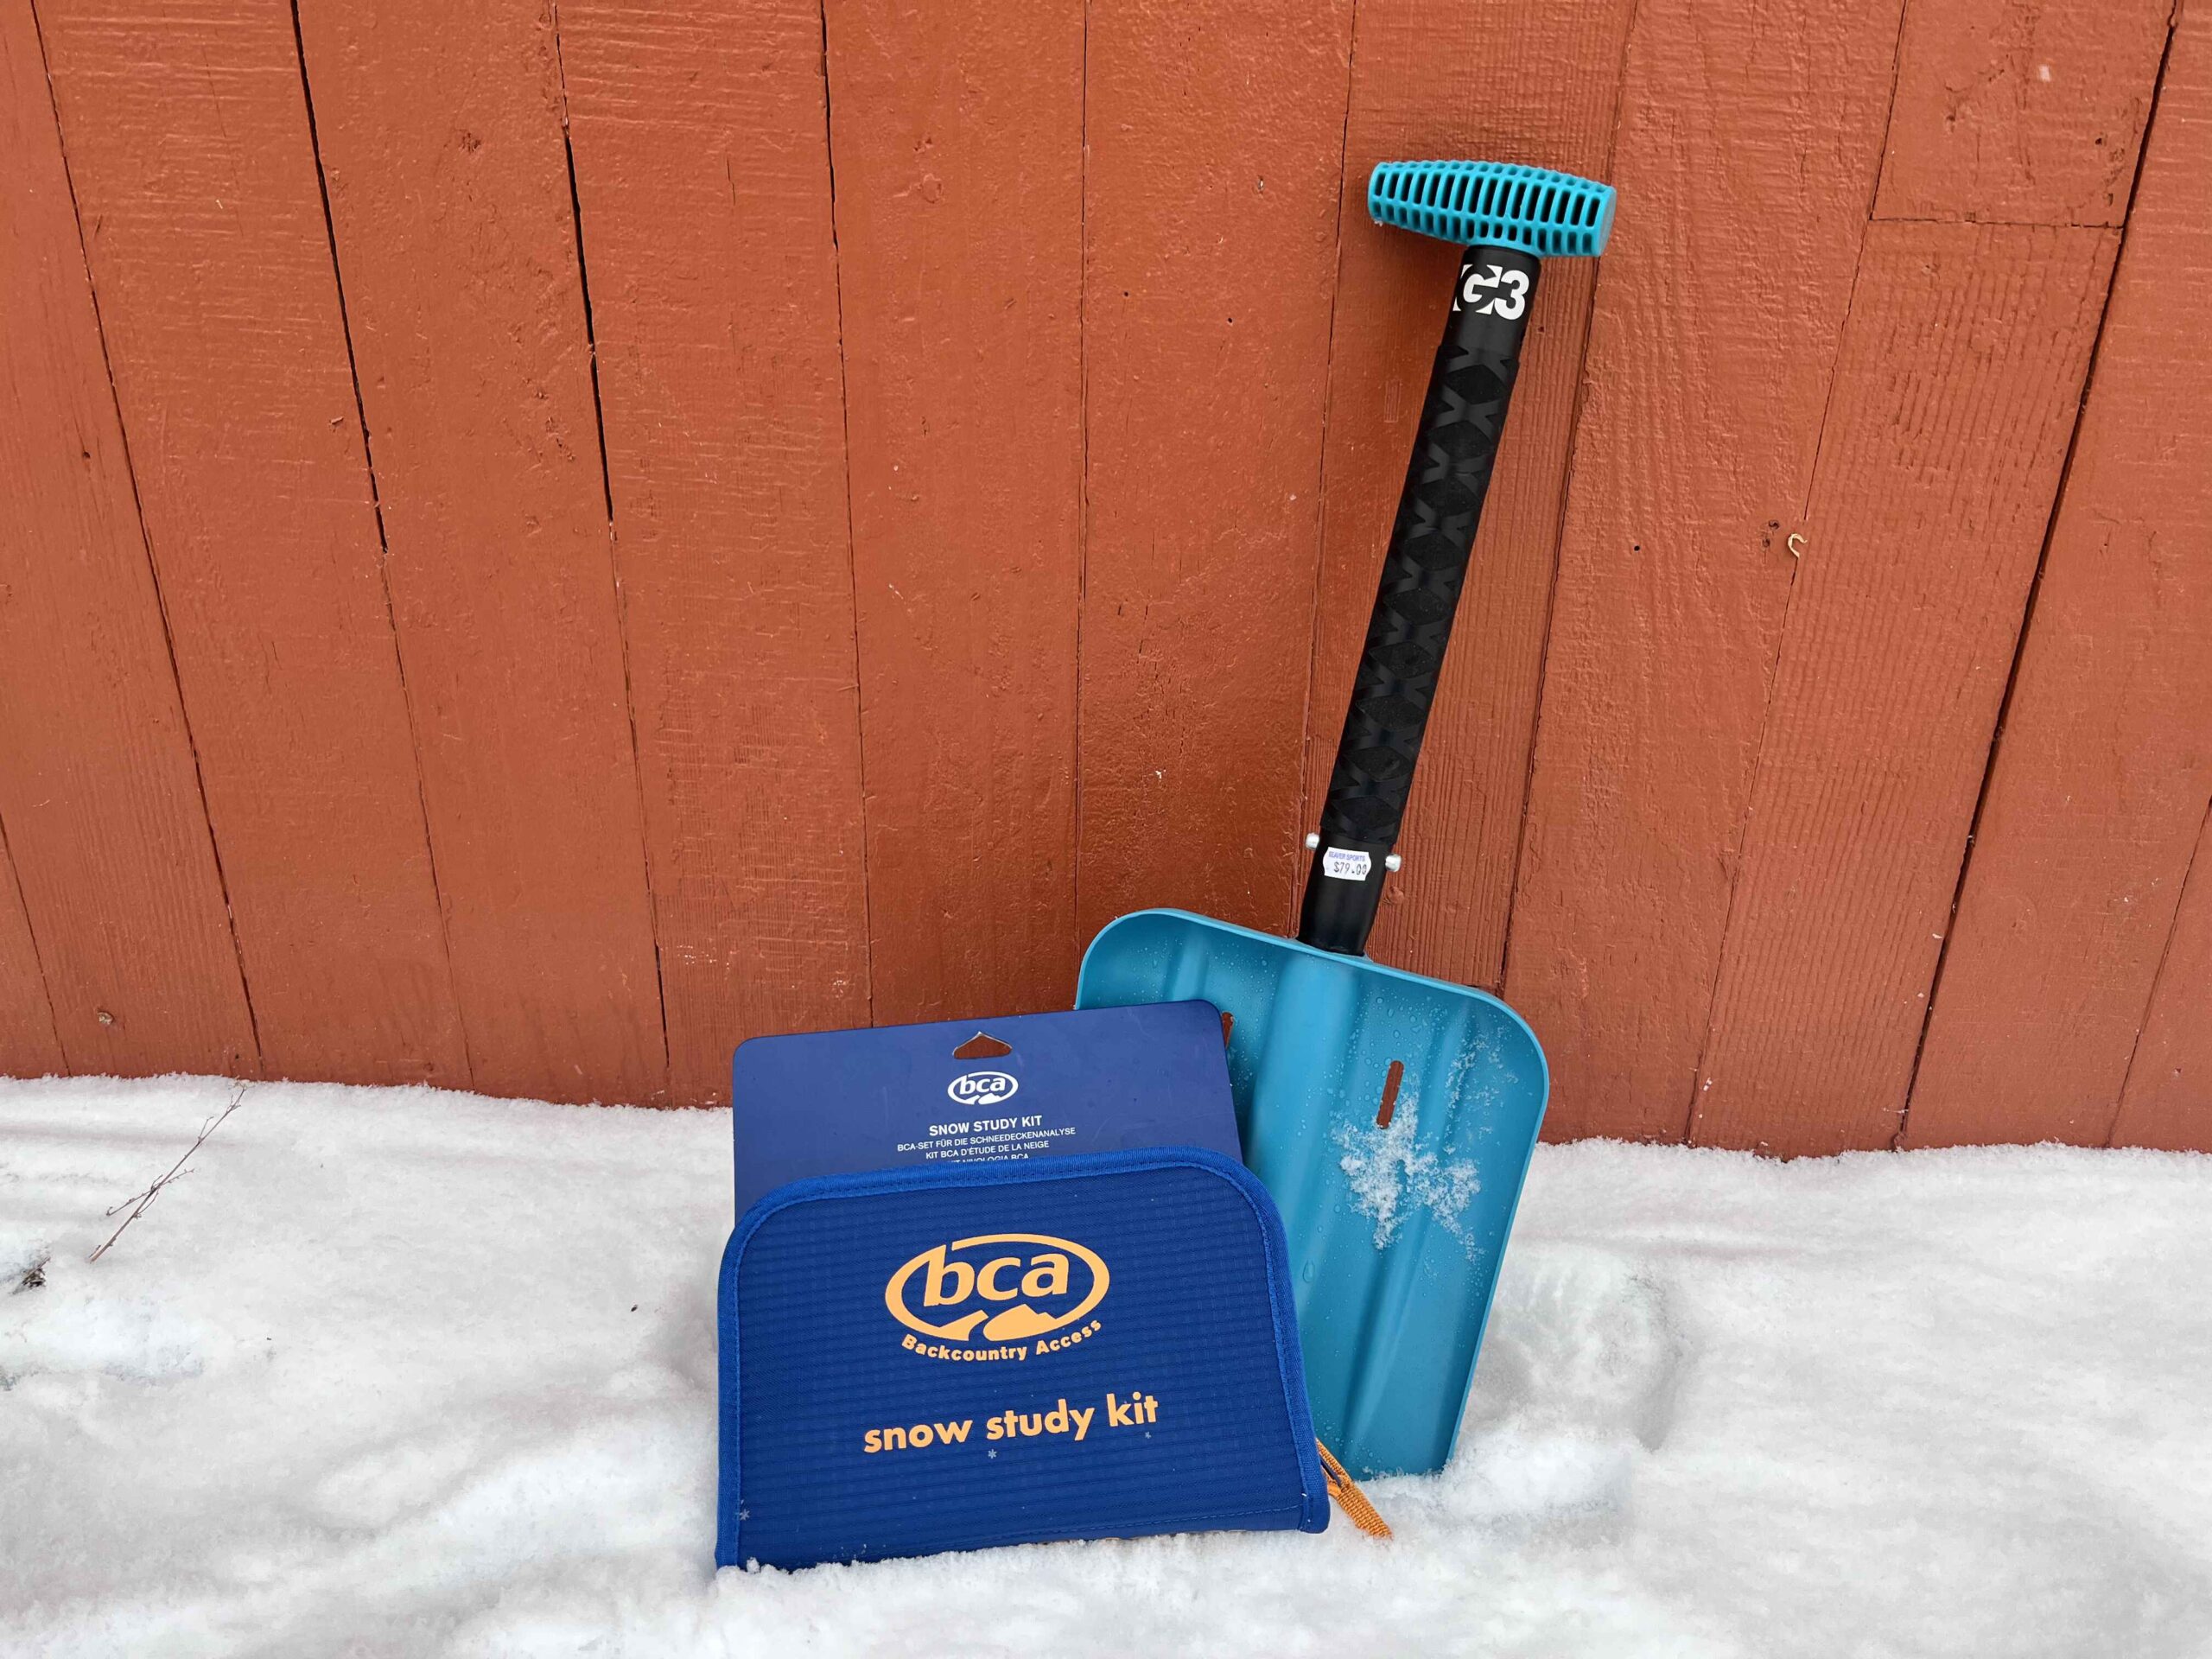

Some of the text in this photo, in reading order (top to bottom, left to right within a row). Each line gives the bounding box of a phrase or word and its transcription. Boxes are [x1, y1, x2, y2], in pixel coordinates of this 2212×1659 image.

[1452, 264, 1529, 320] G3
[1333, 861, 1367, 875] $79.00
[959, 1075, 1006, 1095] bca
[929, 1115, 1042, 1136] SNOW STUDY KIT
[897, 1127, 1076, 1152] BCA-SET FÜR DIE SCHNEEDECKENANALYSE
[925, 1151, 938, 1160] KIT
[940, 1149, 959, 1158] BCA
[960, 1145, 996, 1156] D'ÉTUDE
[998, 1144, 1010, 1153] DE
[1023, 1141, 1050, 1149] NEIGE
[923, 1243, 1070, 1306] bca
[901, 1319, 1102, 1361] Backcountry Access
[864, 1390, 1159, 1453] snow study kit
